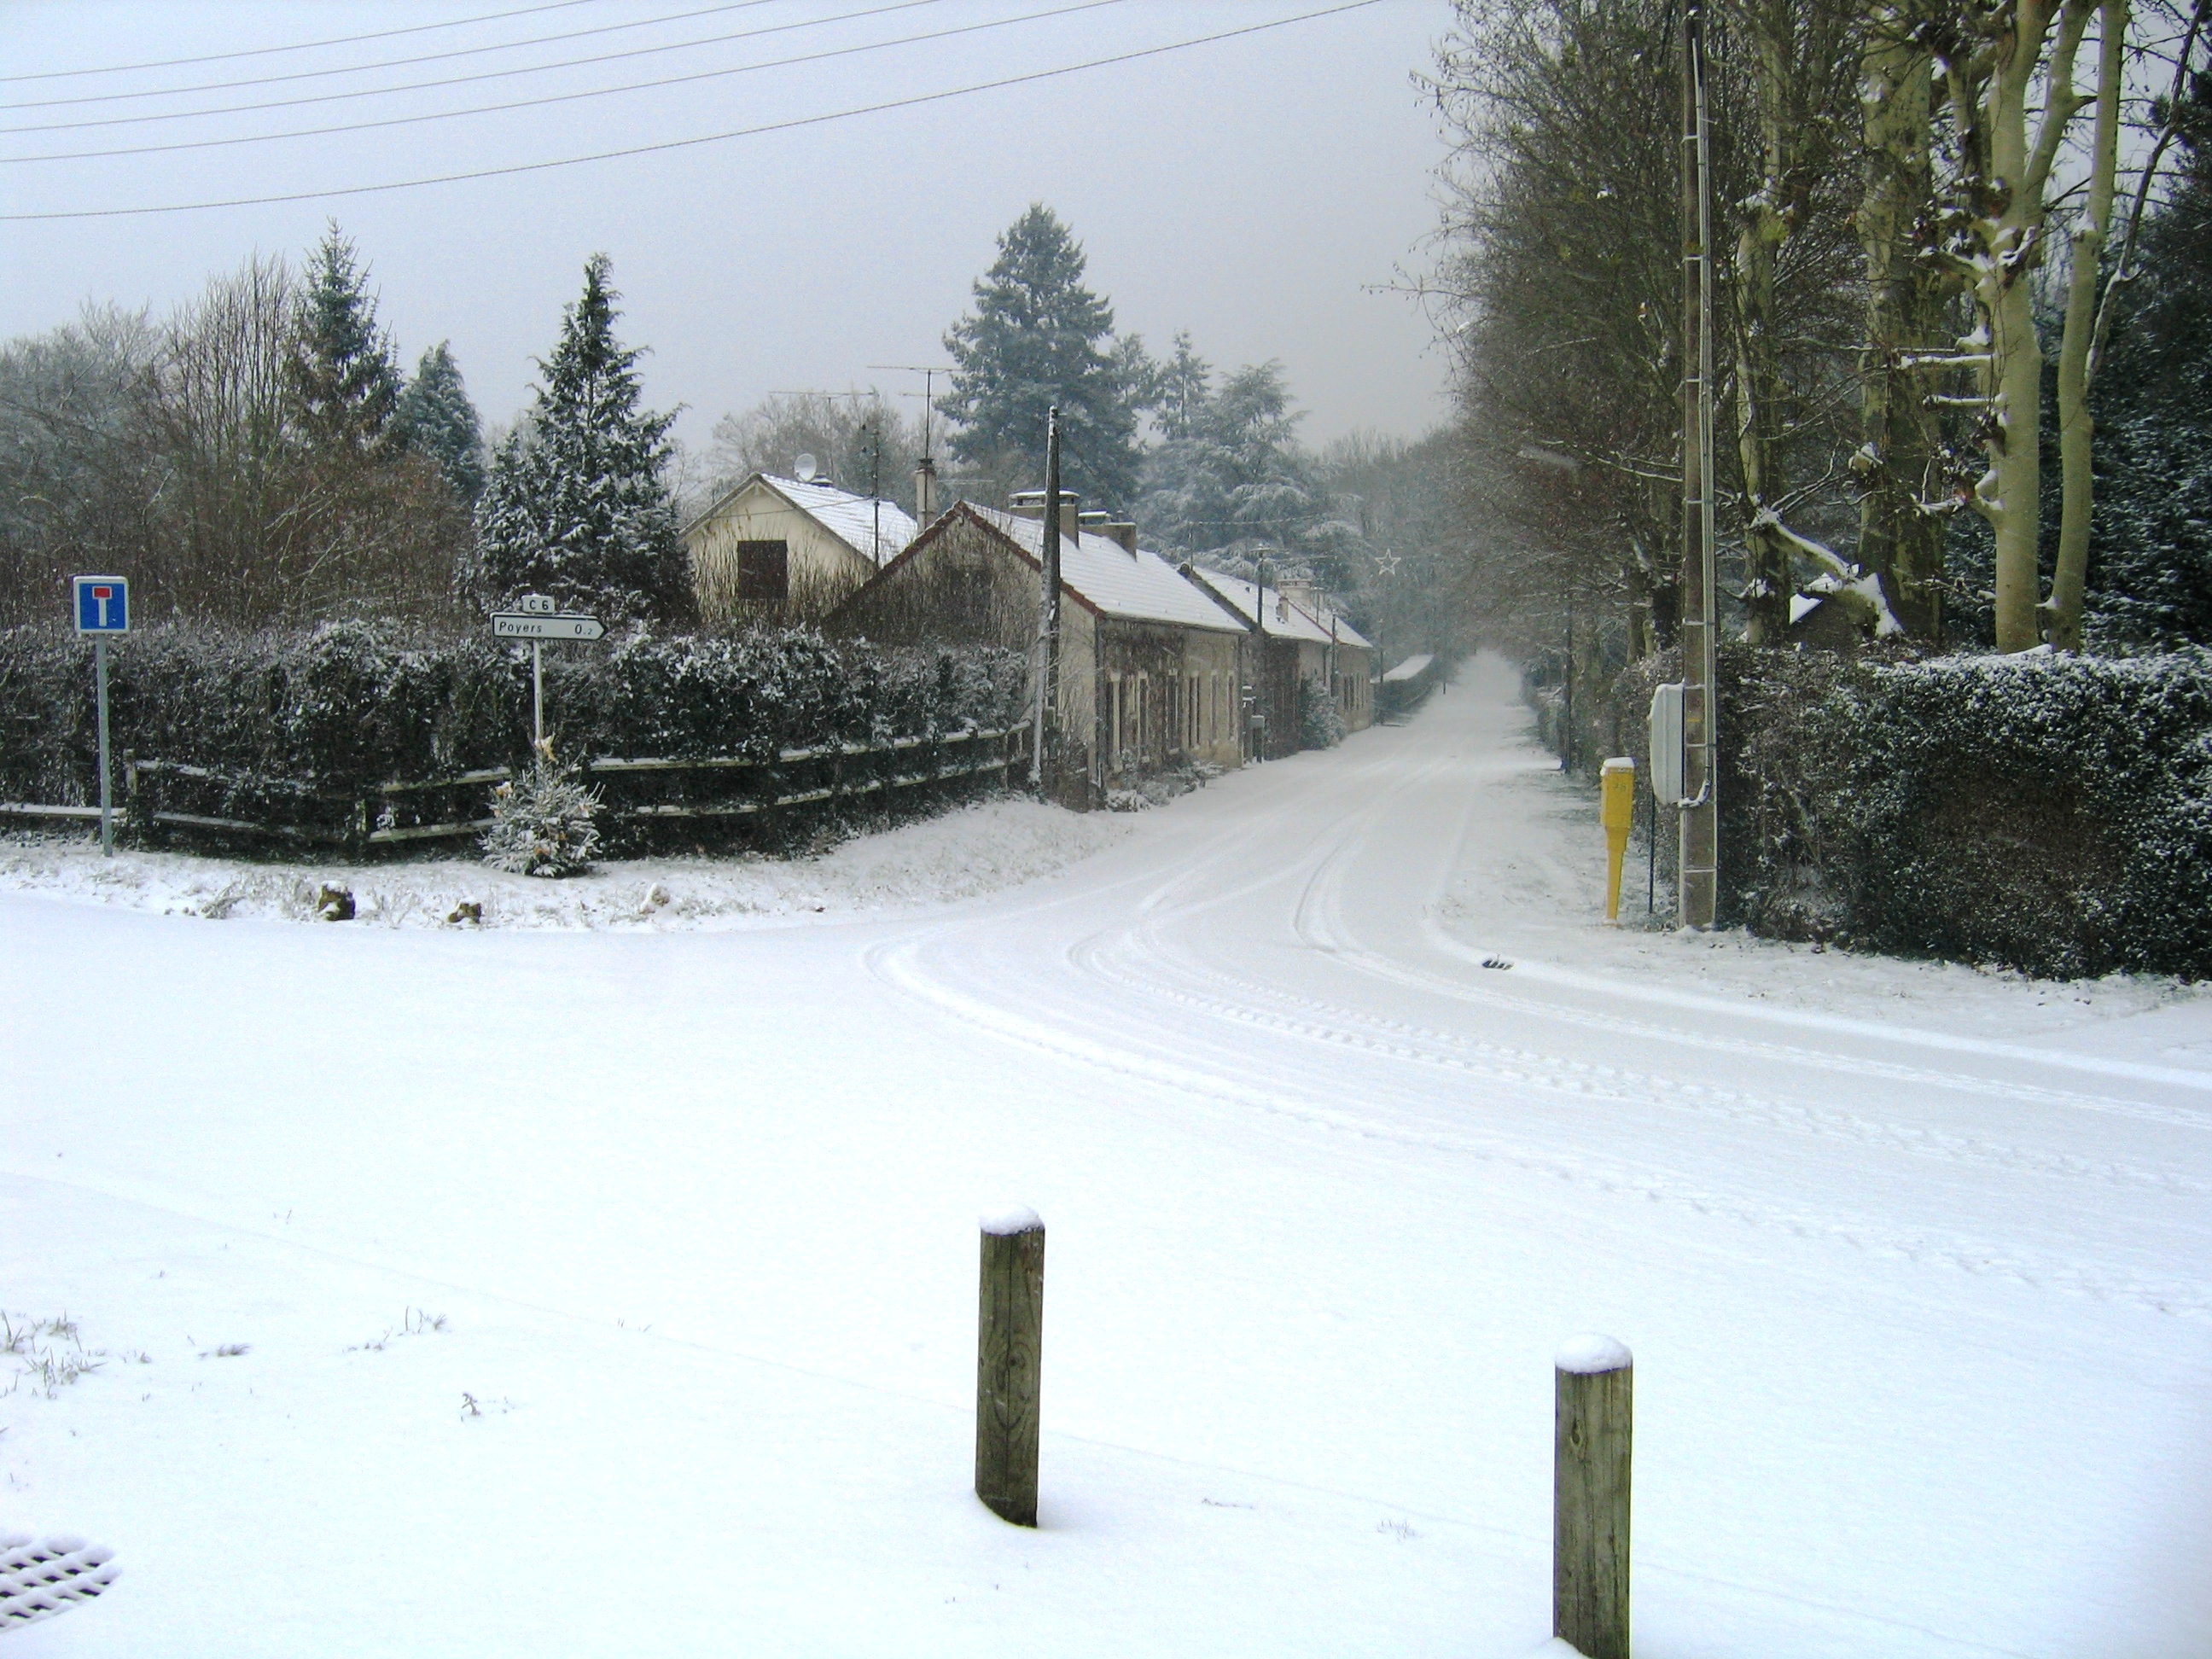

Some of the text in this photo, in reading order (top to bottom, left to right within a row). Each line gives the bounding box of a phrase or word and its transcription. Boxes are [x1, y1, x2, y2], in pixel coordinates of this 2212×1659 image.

[529, 600, 549, 610] C 6
[499, 621, 542, 634] Poyers
